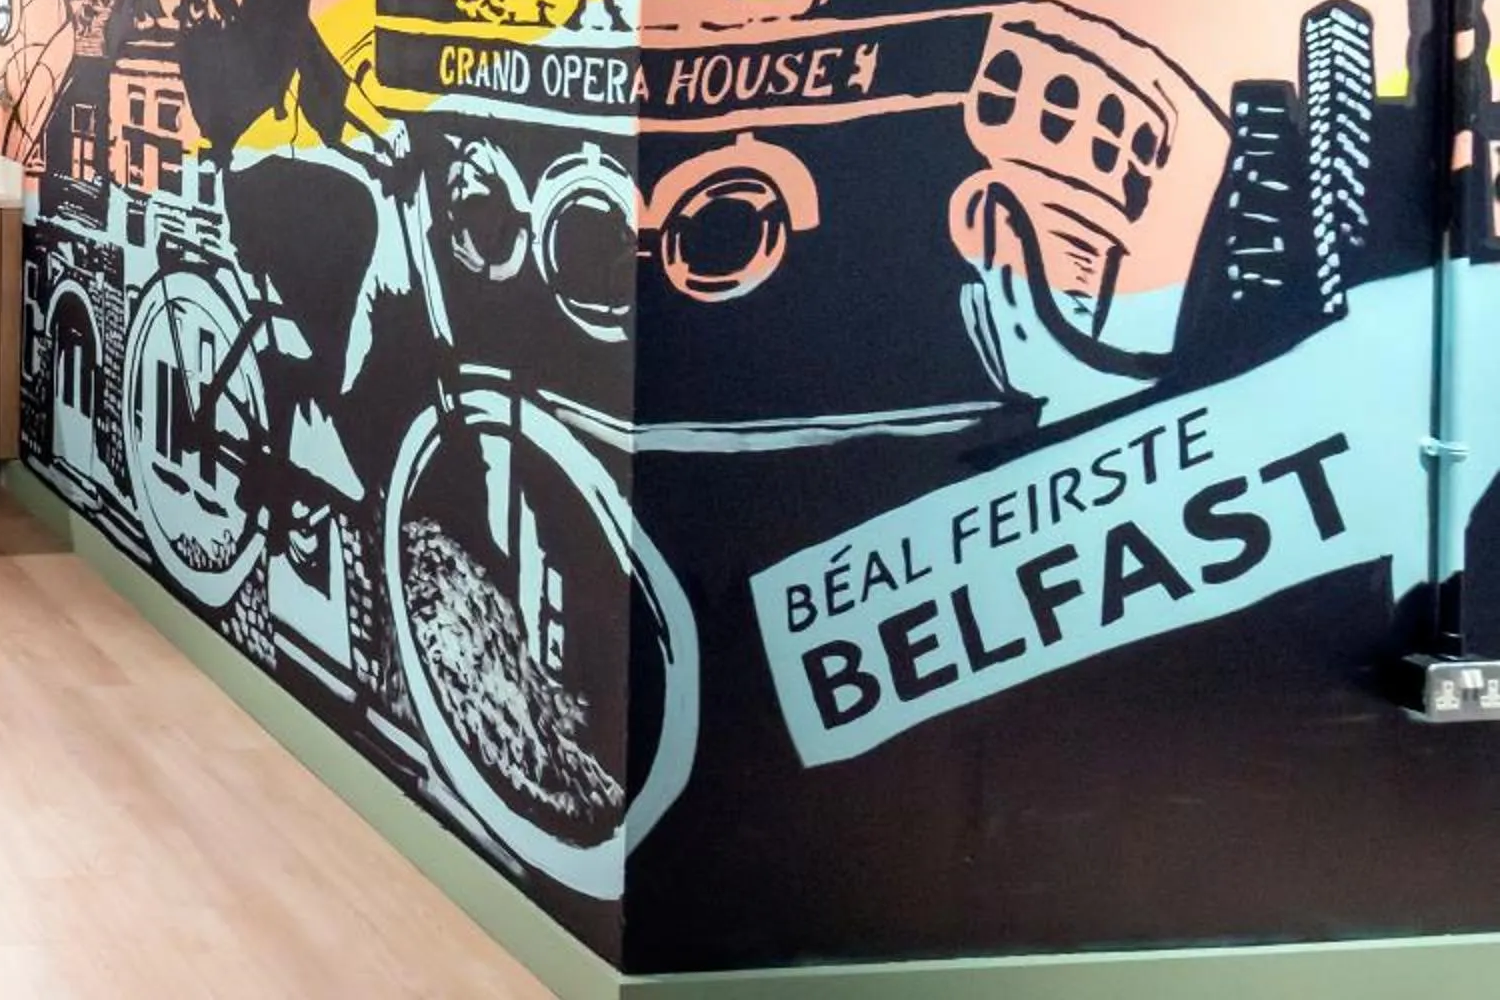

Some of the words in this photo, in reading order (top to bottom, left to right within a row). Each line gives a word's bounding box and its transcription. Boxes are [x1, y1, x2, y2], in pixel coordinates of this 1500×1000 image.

[439, 45, 531, 95] GRAND
[542, 54, 650, 104] OPERA
[665, 48, 843, 105] HOUSE
[786, 544, 932, 632] BÉAL
[951, 406, 1214, 564] FEIRSTE
[801, 431, 1351, 731] BELFAST
